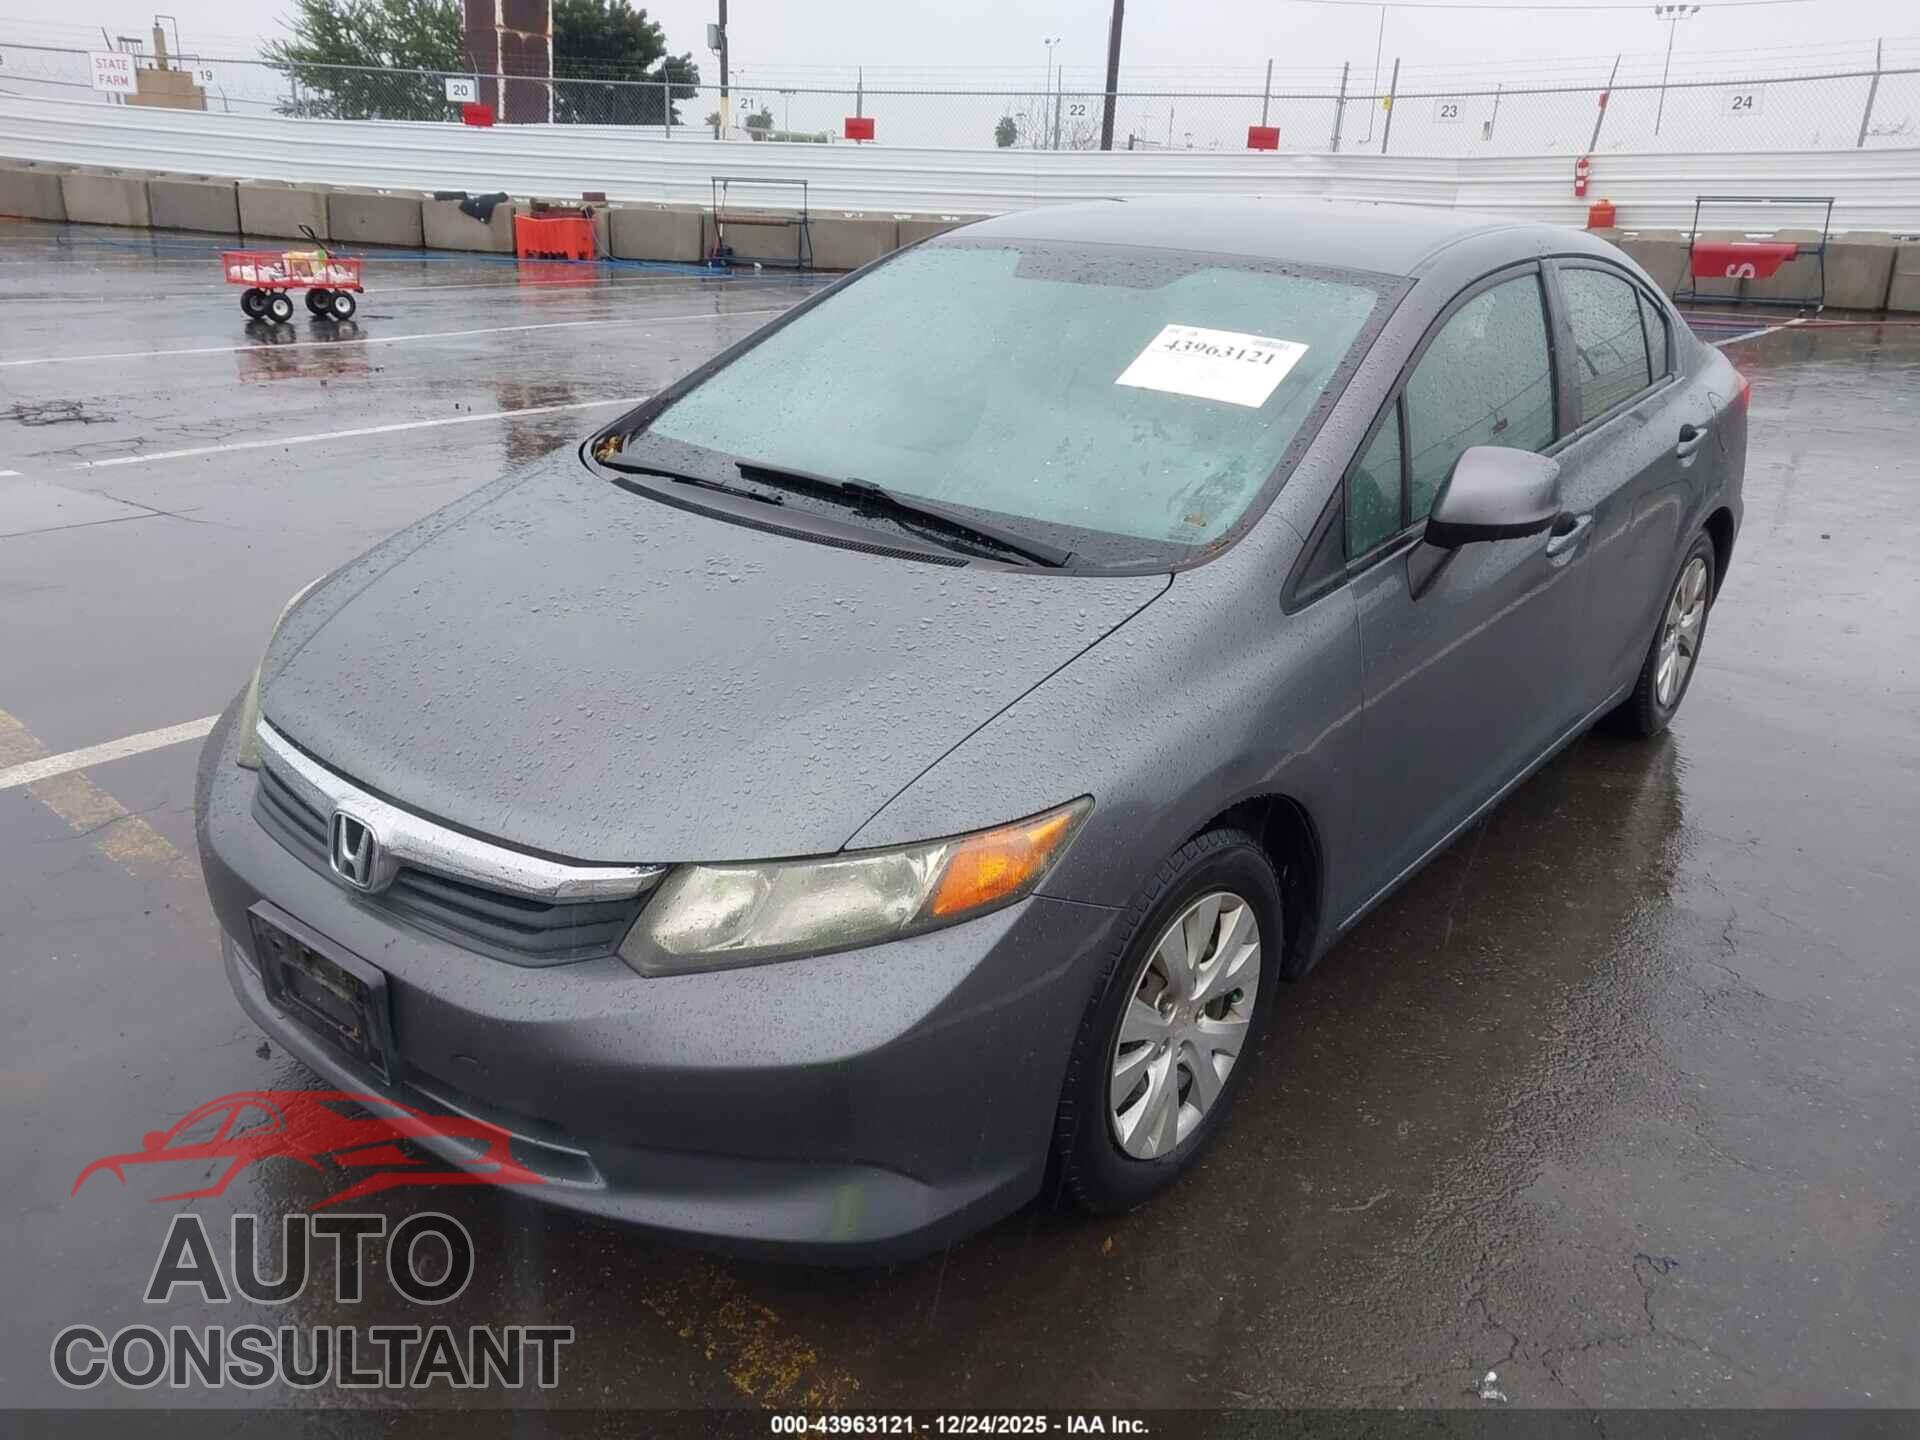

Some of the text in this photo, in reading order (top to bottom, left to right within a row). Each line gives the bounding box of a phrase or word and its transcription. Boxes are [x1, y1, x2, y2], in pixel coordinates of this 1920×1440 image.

[96, 59, 128, 71] STATE
[98, 74, 128, 86] FARM
[199, 70, 213, 81] 19
[453, 84, 468, 97] 20
[740, 97, 754, 110] 21
[1732, 95, 1752, 110] 24
[1070, 104, 1086, 116] 22
[1441, 104, 1457, 118] 23
[1164, 339, 1277, 365] 43963121
